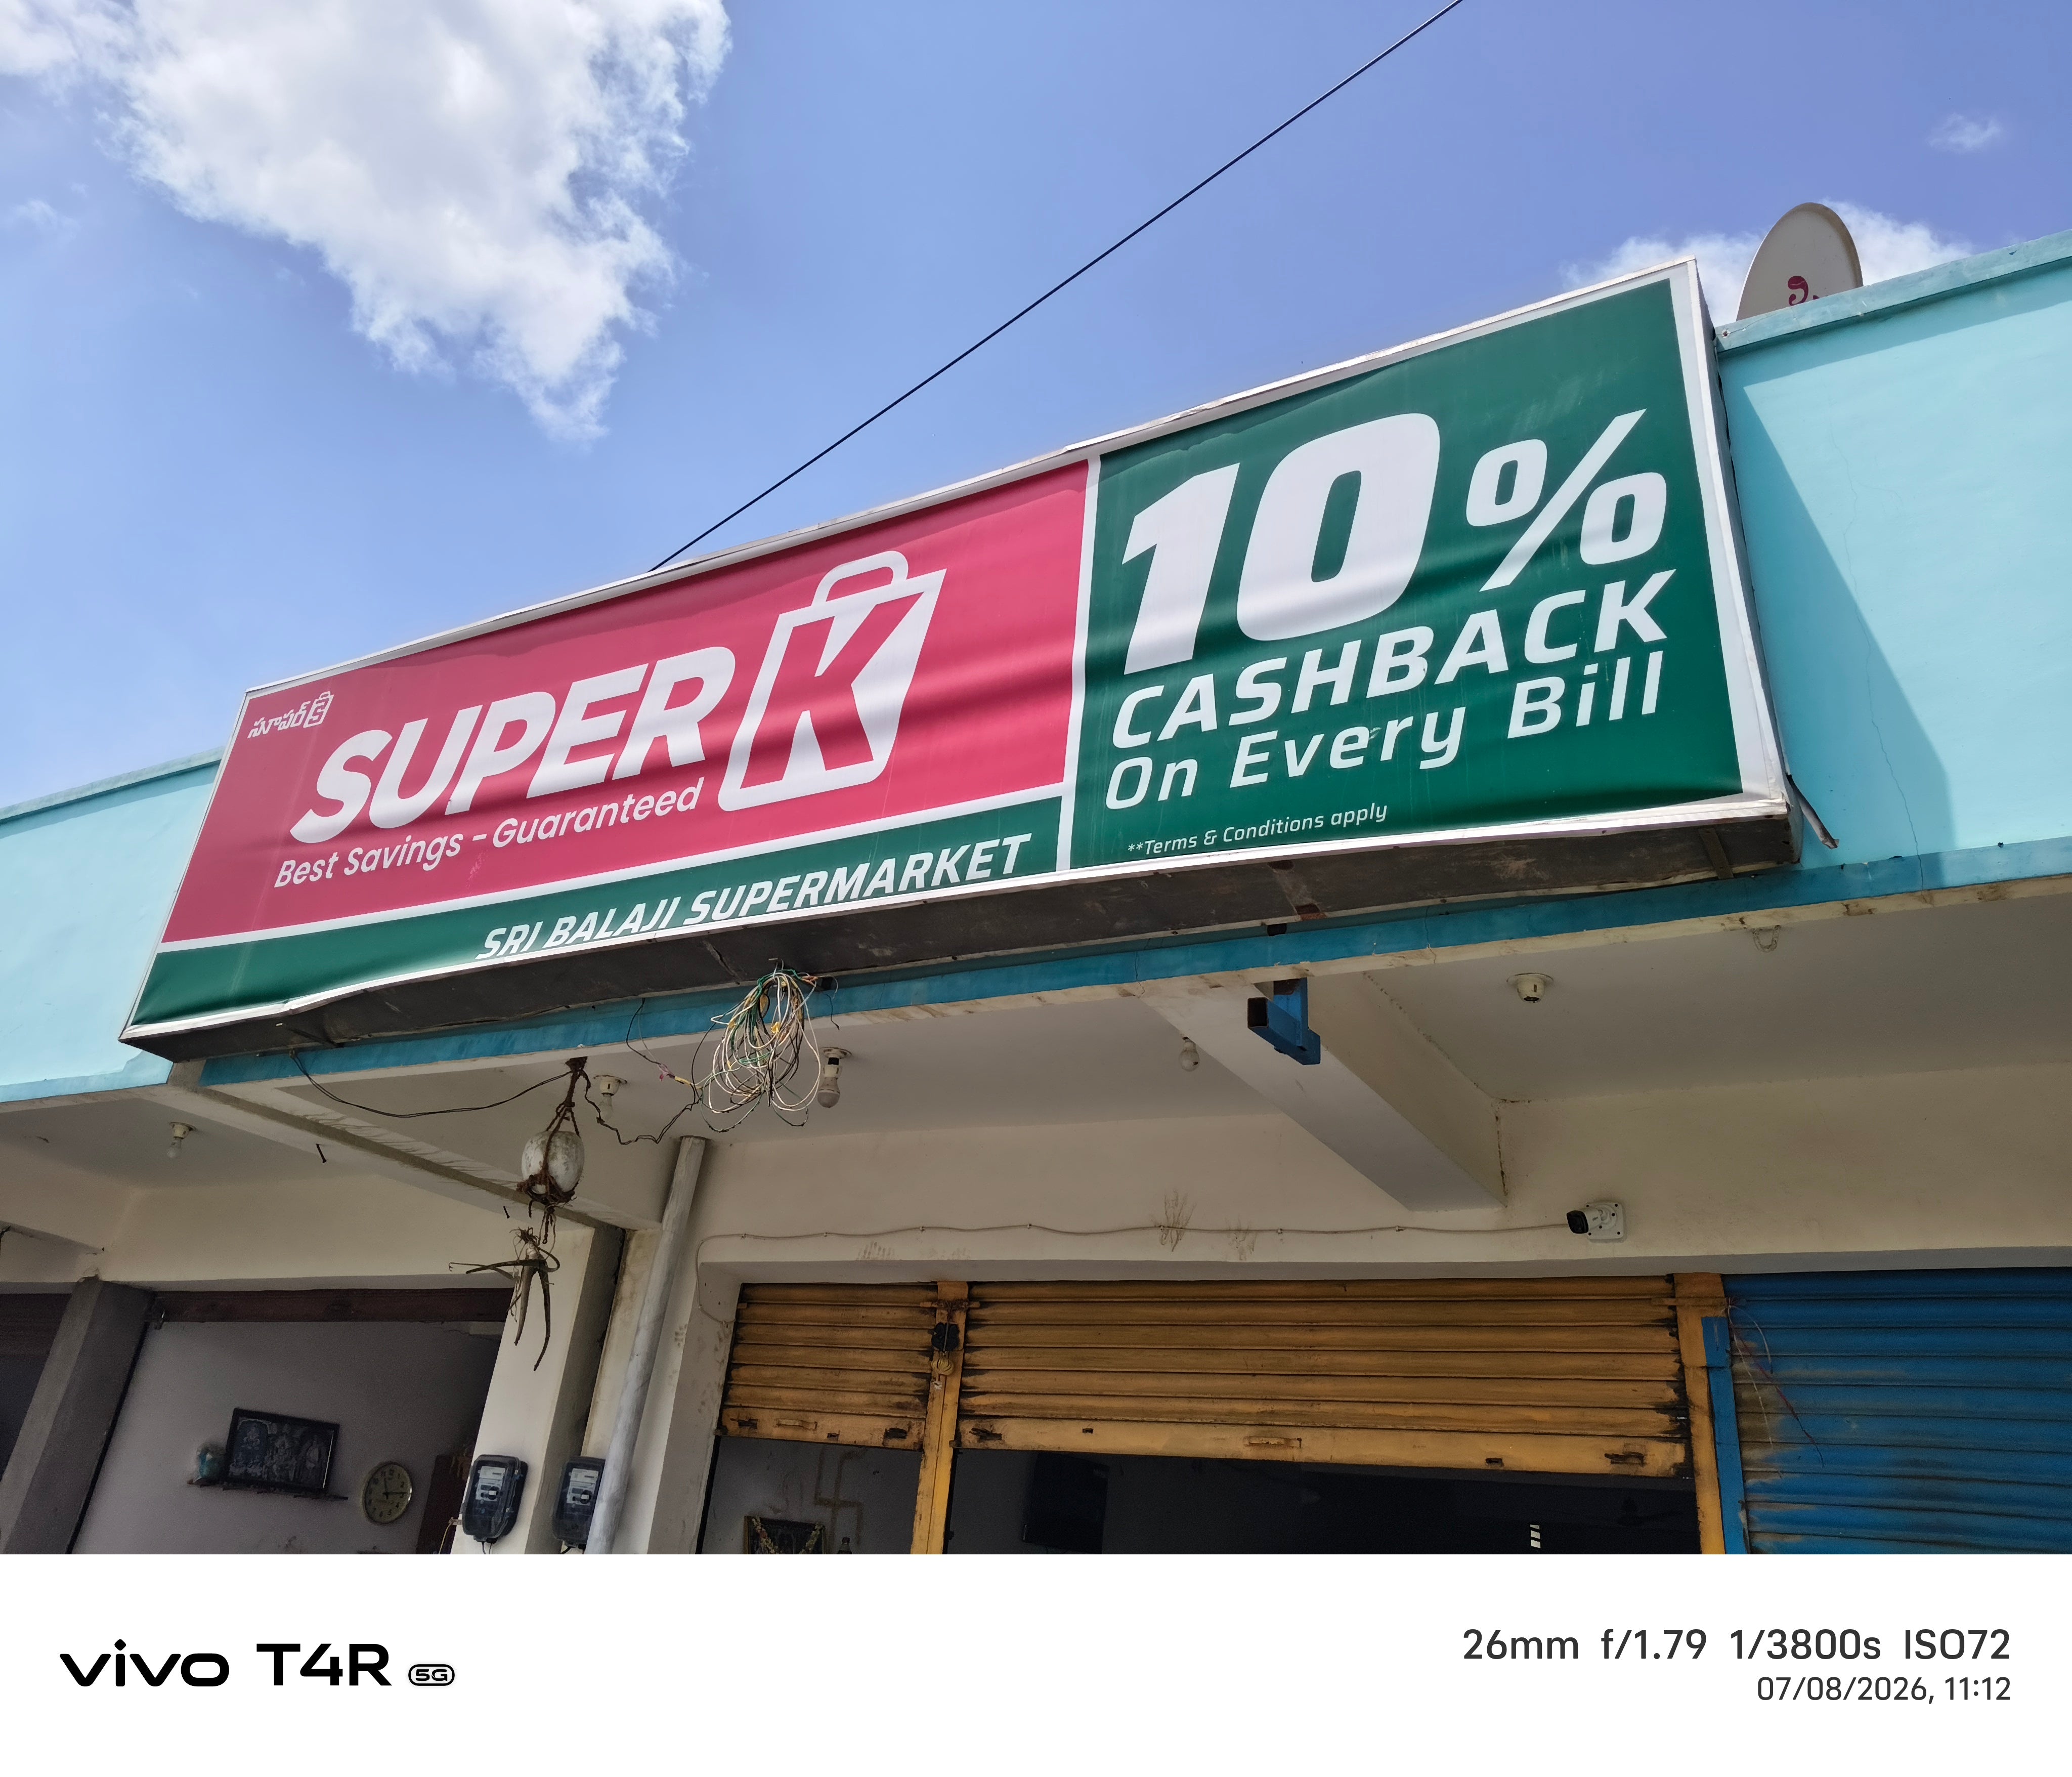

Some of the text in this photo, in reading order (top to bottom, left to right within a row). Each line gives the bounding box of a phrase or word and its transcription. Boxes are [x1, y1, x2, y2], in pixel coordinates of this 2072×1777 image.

[1122, 409, 1666, 674] 10%
[1106, 651, 1663, 809] On Every Bill
[1113, 570, 1676, 748] CASHBACK
[290, 647, 736, 843] SUPER
[1203, 830, 1217, 845] &
[1223, 816, 1324, 842] Conditions
[1331, 803, 1387, 827] apply
[275, 853, 338, 887] Best
[344, 833, 463, 875] Savings
[493, 777, 704, 848] Guaranteed
[475, 832, 1032, 959] SRI BALAJI SUPERMARKET
